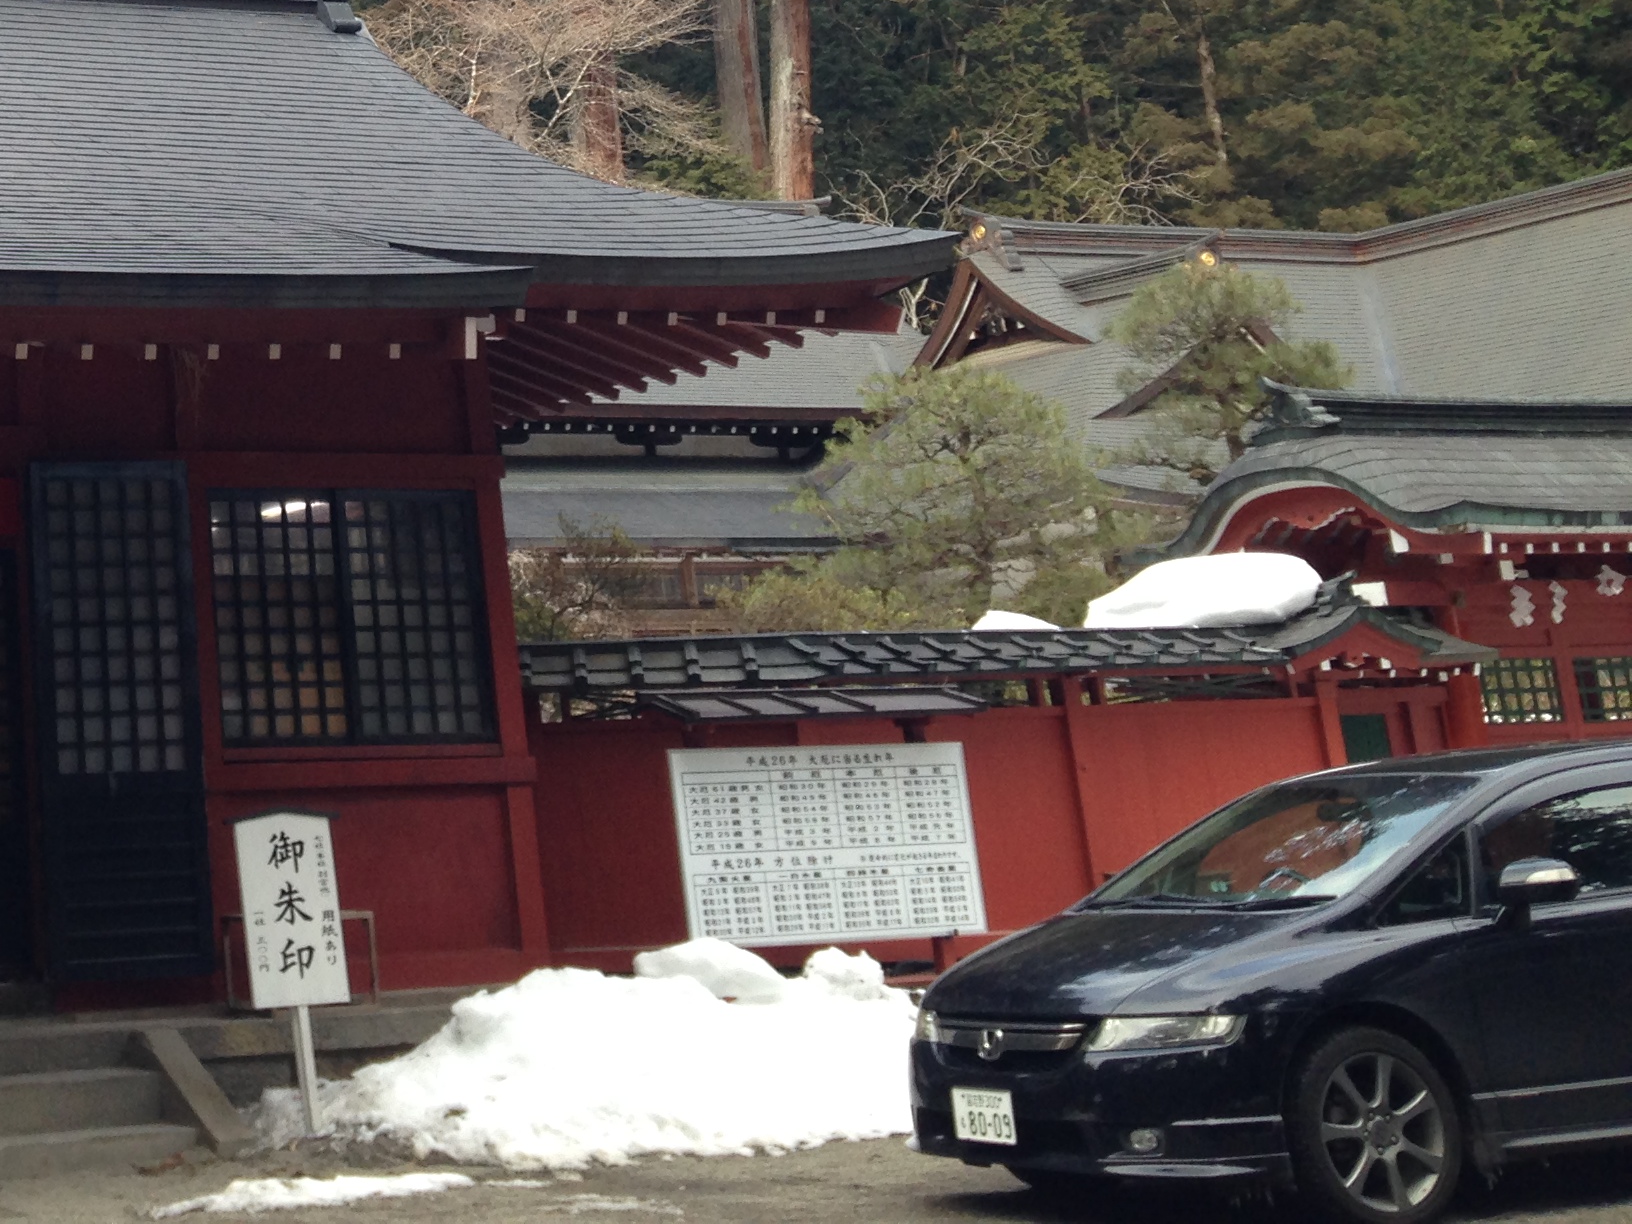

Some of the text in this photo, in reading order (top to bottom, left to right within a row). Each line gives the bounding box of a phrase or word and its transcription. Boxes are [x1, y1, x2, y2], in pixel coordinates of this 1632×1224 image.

[711, 857, 764, 870] 平成26年
[267, 830, 316, 980] 御朱印
[968, 1110, 1013, 1139] 80-09
